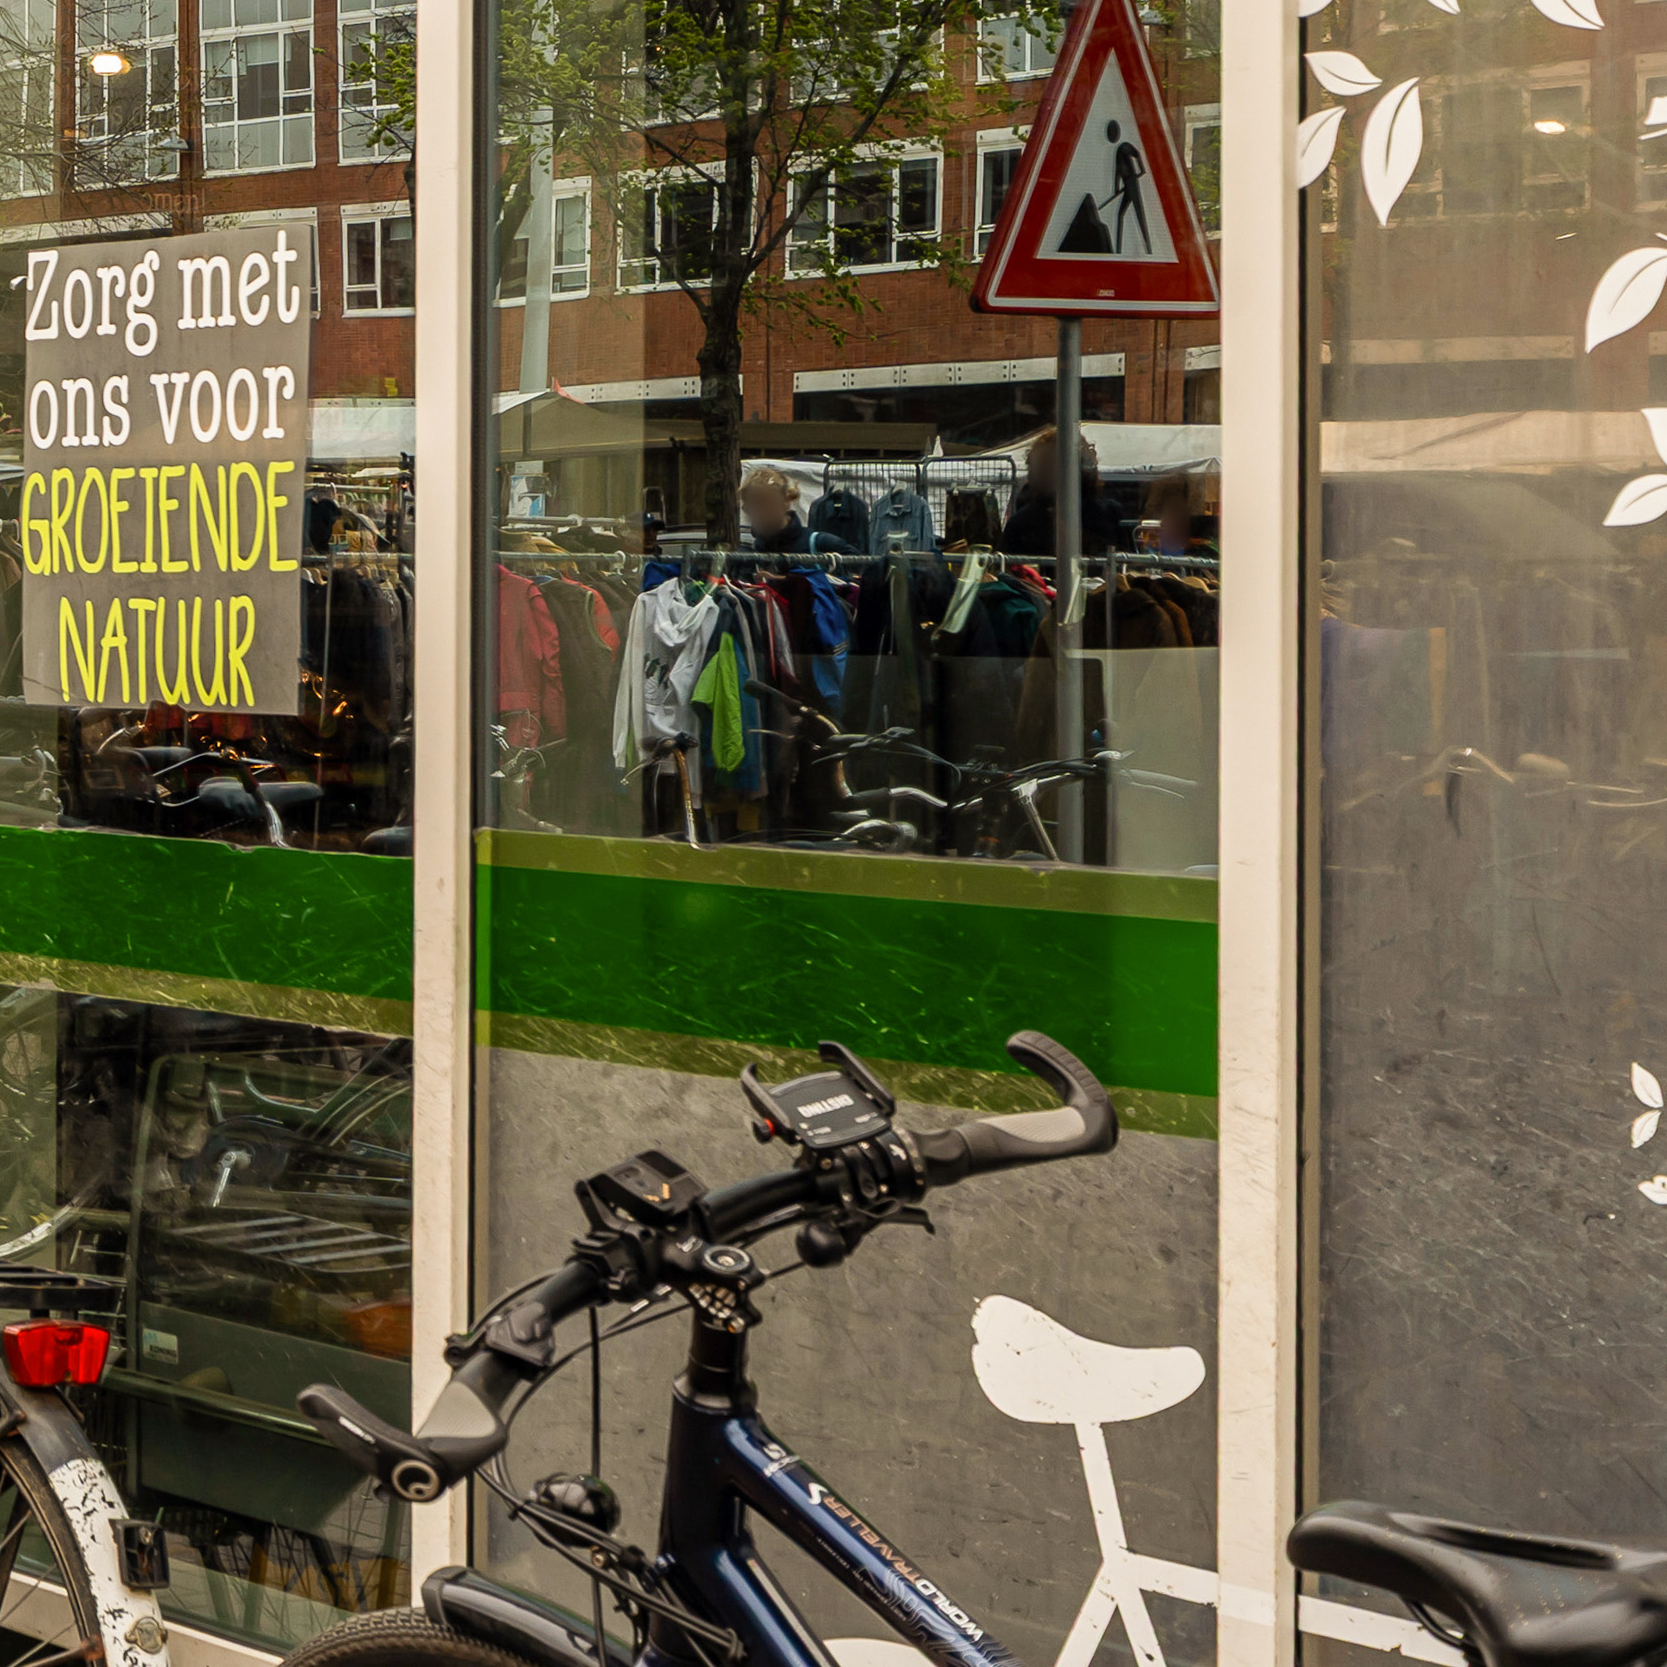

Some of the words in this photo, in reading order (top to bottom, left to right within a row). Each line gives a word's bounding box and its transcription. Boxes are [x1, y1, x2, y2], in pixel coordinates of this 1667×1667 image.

[24, 249, 160, 357] Zorg
[177, 229, 301, 330] met
[28, 374, 131, 450] ons
[149, 365, 295, 446] voor
[21, 460, 299, 576] GROEIENDE
[59, 595, 256, 708] NATUUR
